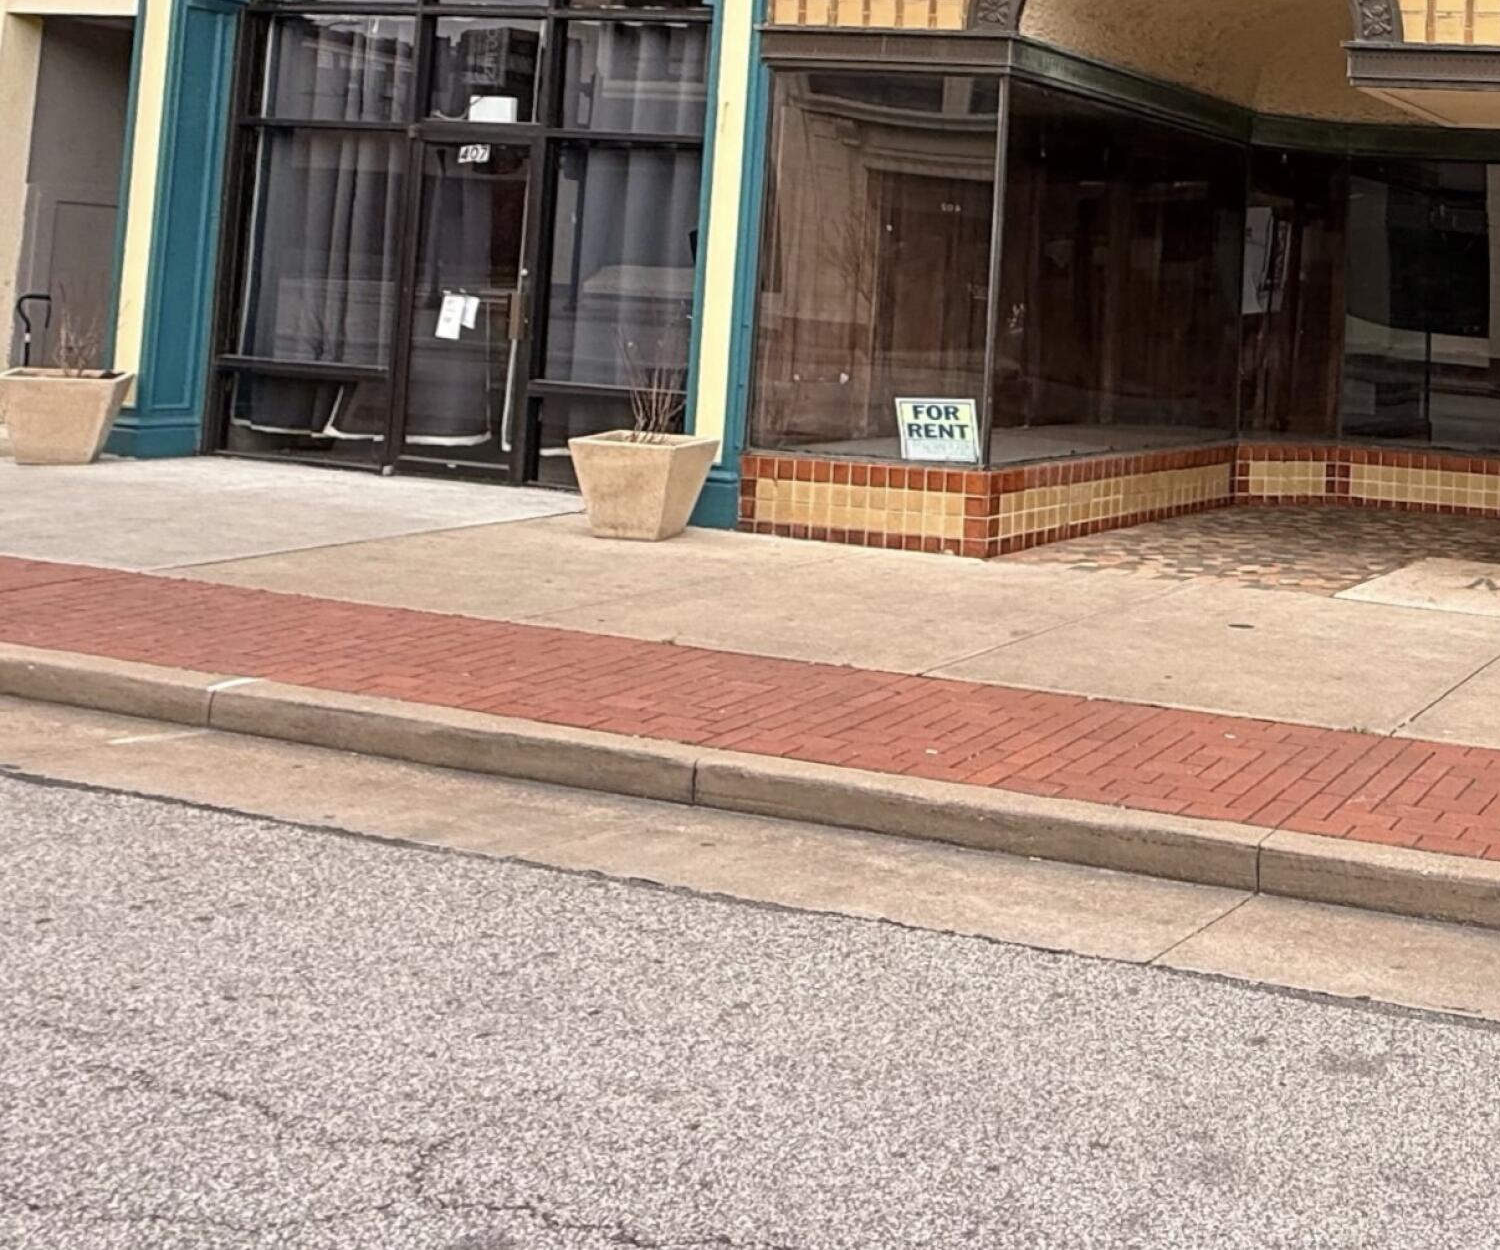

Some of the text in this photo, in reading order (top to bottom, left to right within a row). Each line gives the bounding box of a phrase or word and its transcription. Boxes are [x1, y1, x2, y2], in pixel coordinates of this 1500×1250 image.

[460, 145, 489, 160] 407
[912, 405, 960, 421] FOR
[907, 423, 969, 439] RENT
